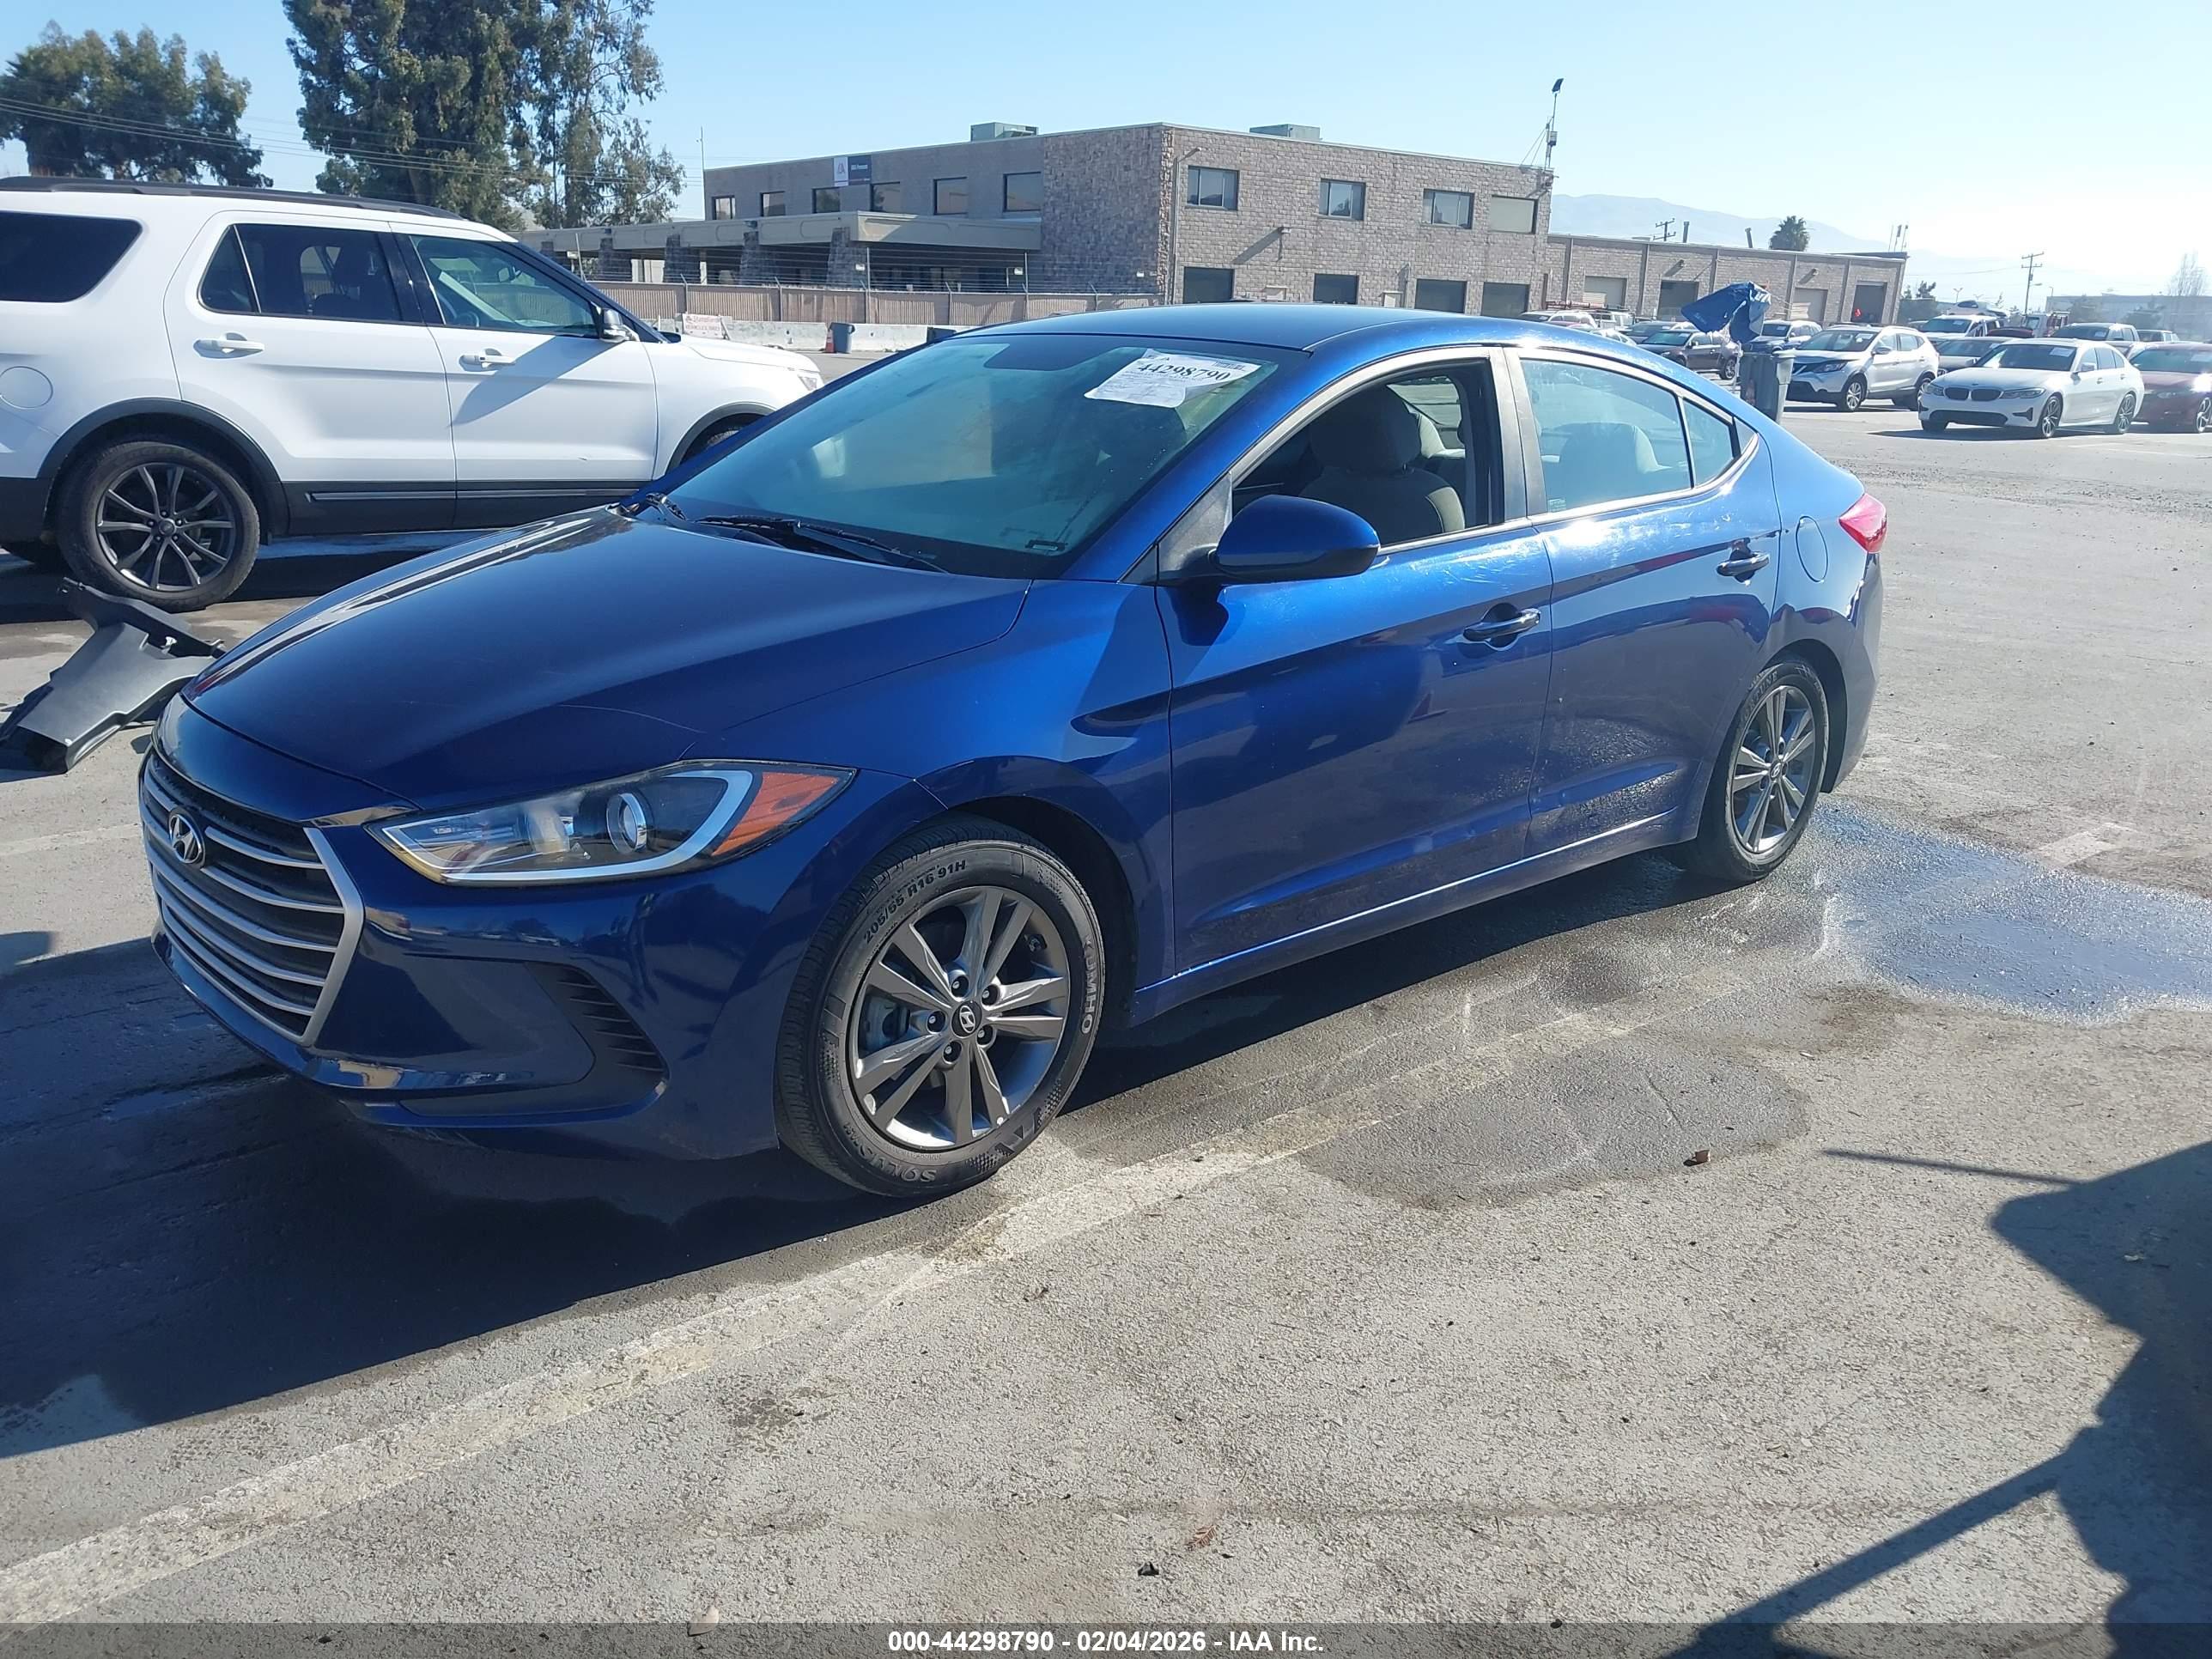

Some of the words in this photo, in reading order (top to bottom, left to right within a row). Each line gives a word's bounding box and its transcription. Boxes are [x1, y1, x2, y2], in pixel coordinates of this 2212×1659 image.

[1137, 363, 1231, 380] 44298790
[863, 894, 906, 945] 205/55
[906, 872, 935, 898] R16
[937, 859, 967, 878] 91H
[1082, 933, 1098, 1034] KUMHO
